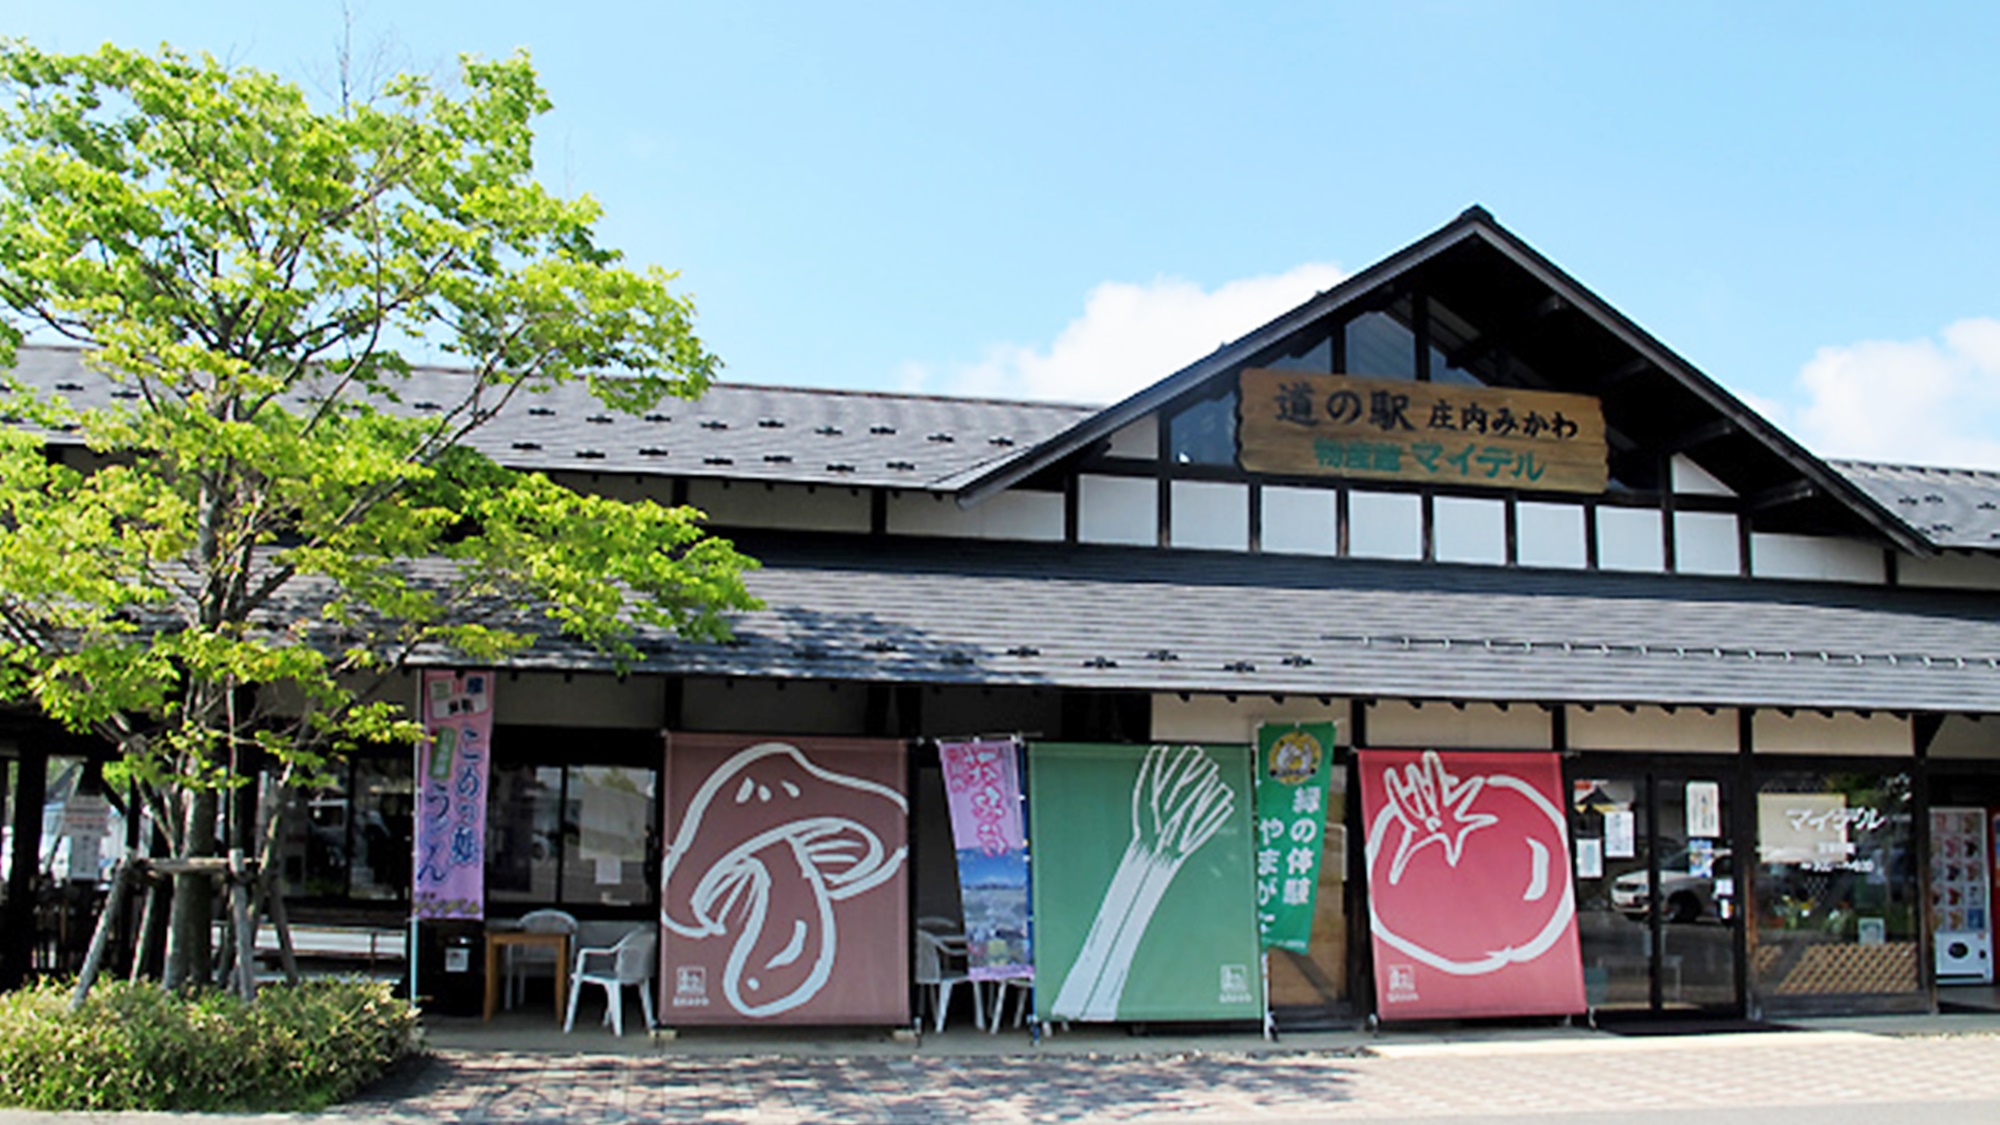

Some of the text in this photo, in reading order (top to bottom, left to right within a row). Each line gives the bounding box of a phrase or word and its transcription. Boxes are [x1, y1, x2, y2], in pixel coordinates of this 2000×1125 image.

[1276, 382, 1578, 438] 道の駅 庄内みかわ
[1410, 441, 1545, 482] マイテル
[1786, 807, 1887, 831] マイテル
